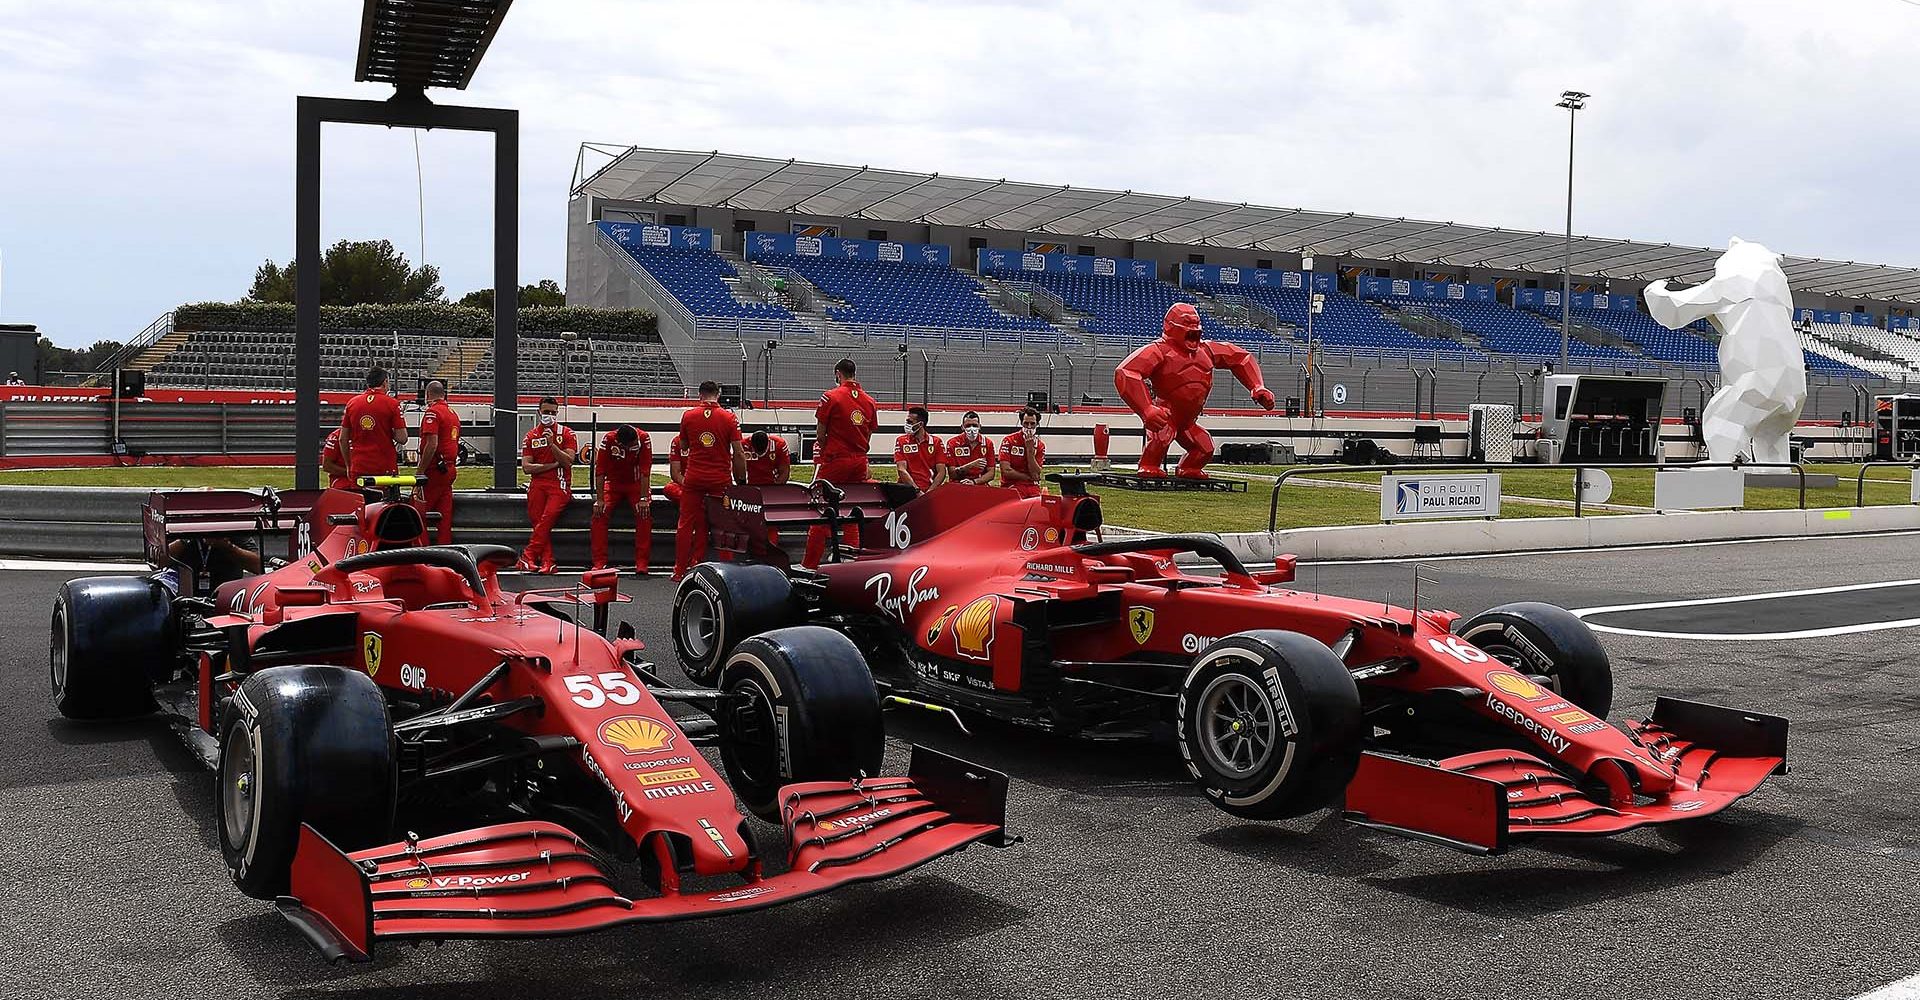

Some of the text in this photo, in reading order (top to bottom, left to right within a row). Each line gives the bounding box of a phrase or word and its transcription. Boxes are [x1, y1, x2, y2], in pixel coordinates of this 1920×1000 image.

[1423, 485, 1481, 494] CIRCUIT
[730, 499, 762, 514] V-Power
[1423, 495, 1481, 507] PAUL RICARD
[885, 511, 911, 549] 16
[1026, 562, 1075, 574] RICHARD MILLE
[865, 566, 939, 624] Ray-Ban
[1427, 637, 1488, 664] 16
[1504, 624, 1554, 673] PIRELLI
[943, 670, 961, 682] SKF
[563, 671, 641, 709] 55
[1263, 666, 1298, 738] PIRELLI
[1486, 692, 1571, 754] kaspersky
[624, 755, 691, 770] kaspersky
[582, 743, 633, 823] kaspersky
[644, 781, 716, 799] MAHLE
[833, 807, 893, 829] V-Power
[433, 871, 531, 888] V-Power
